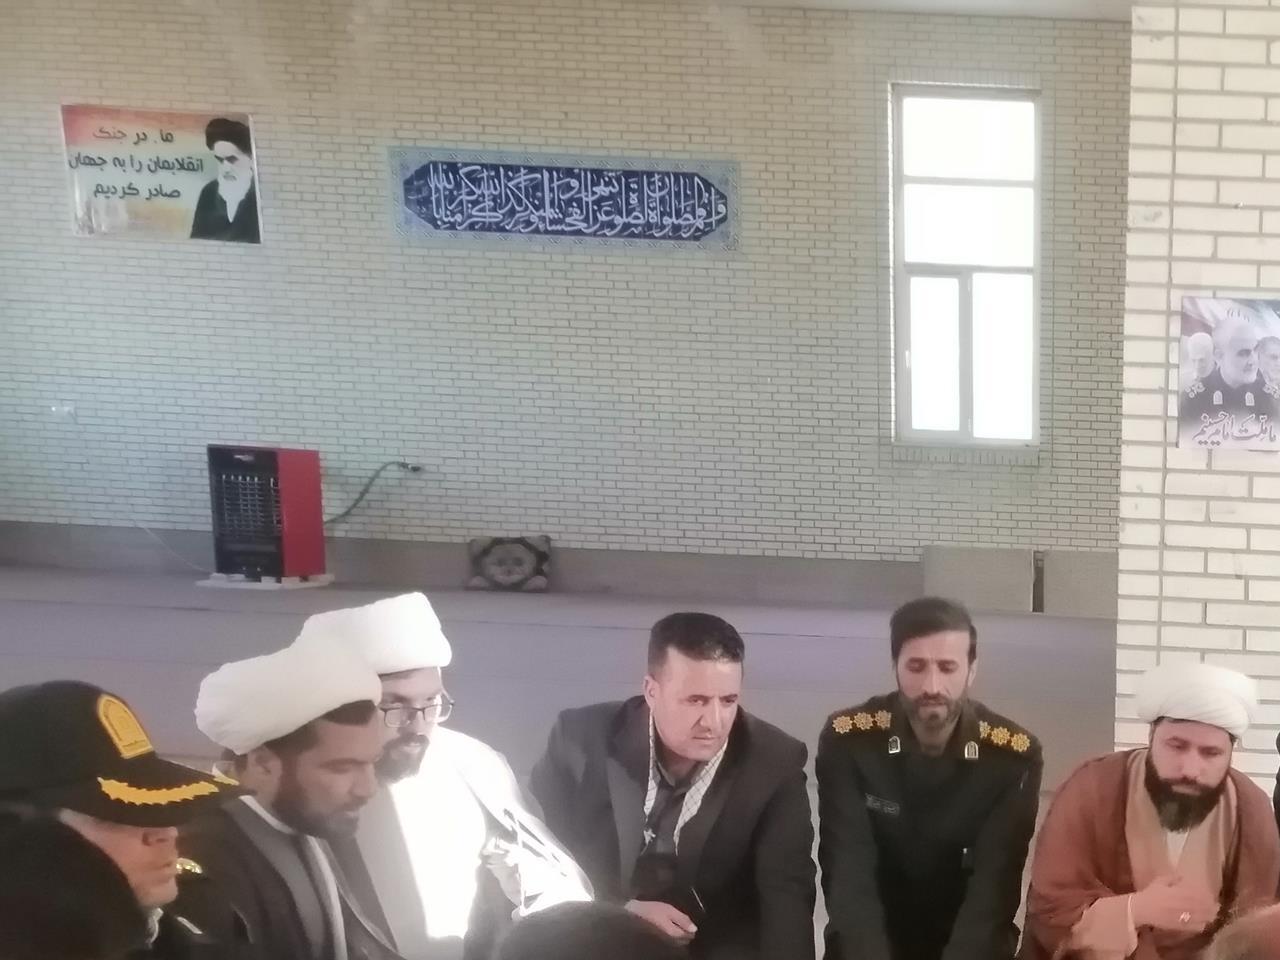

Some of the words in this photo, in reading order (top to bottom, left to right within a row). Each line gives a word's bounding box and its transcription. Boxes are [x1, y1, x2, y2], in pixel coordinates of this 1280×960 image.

[93, 126, 127, 141] جنگ
[133, 131, 148, 146] در
[159, 128, 174, 143] ما
[68, 151, 107, 172] جهان
[112, 154, 127, 173] به
[130, 155, 143, 173] را
[148, 156, 205, 177] انقلابمان
[94, 180, 139, 200] کردیم
[147, 182, 181, 201] صادر
